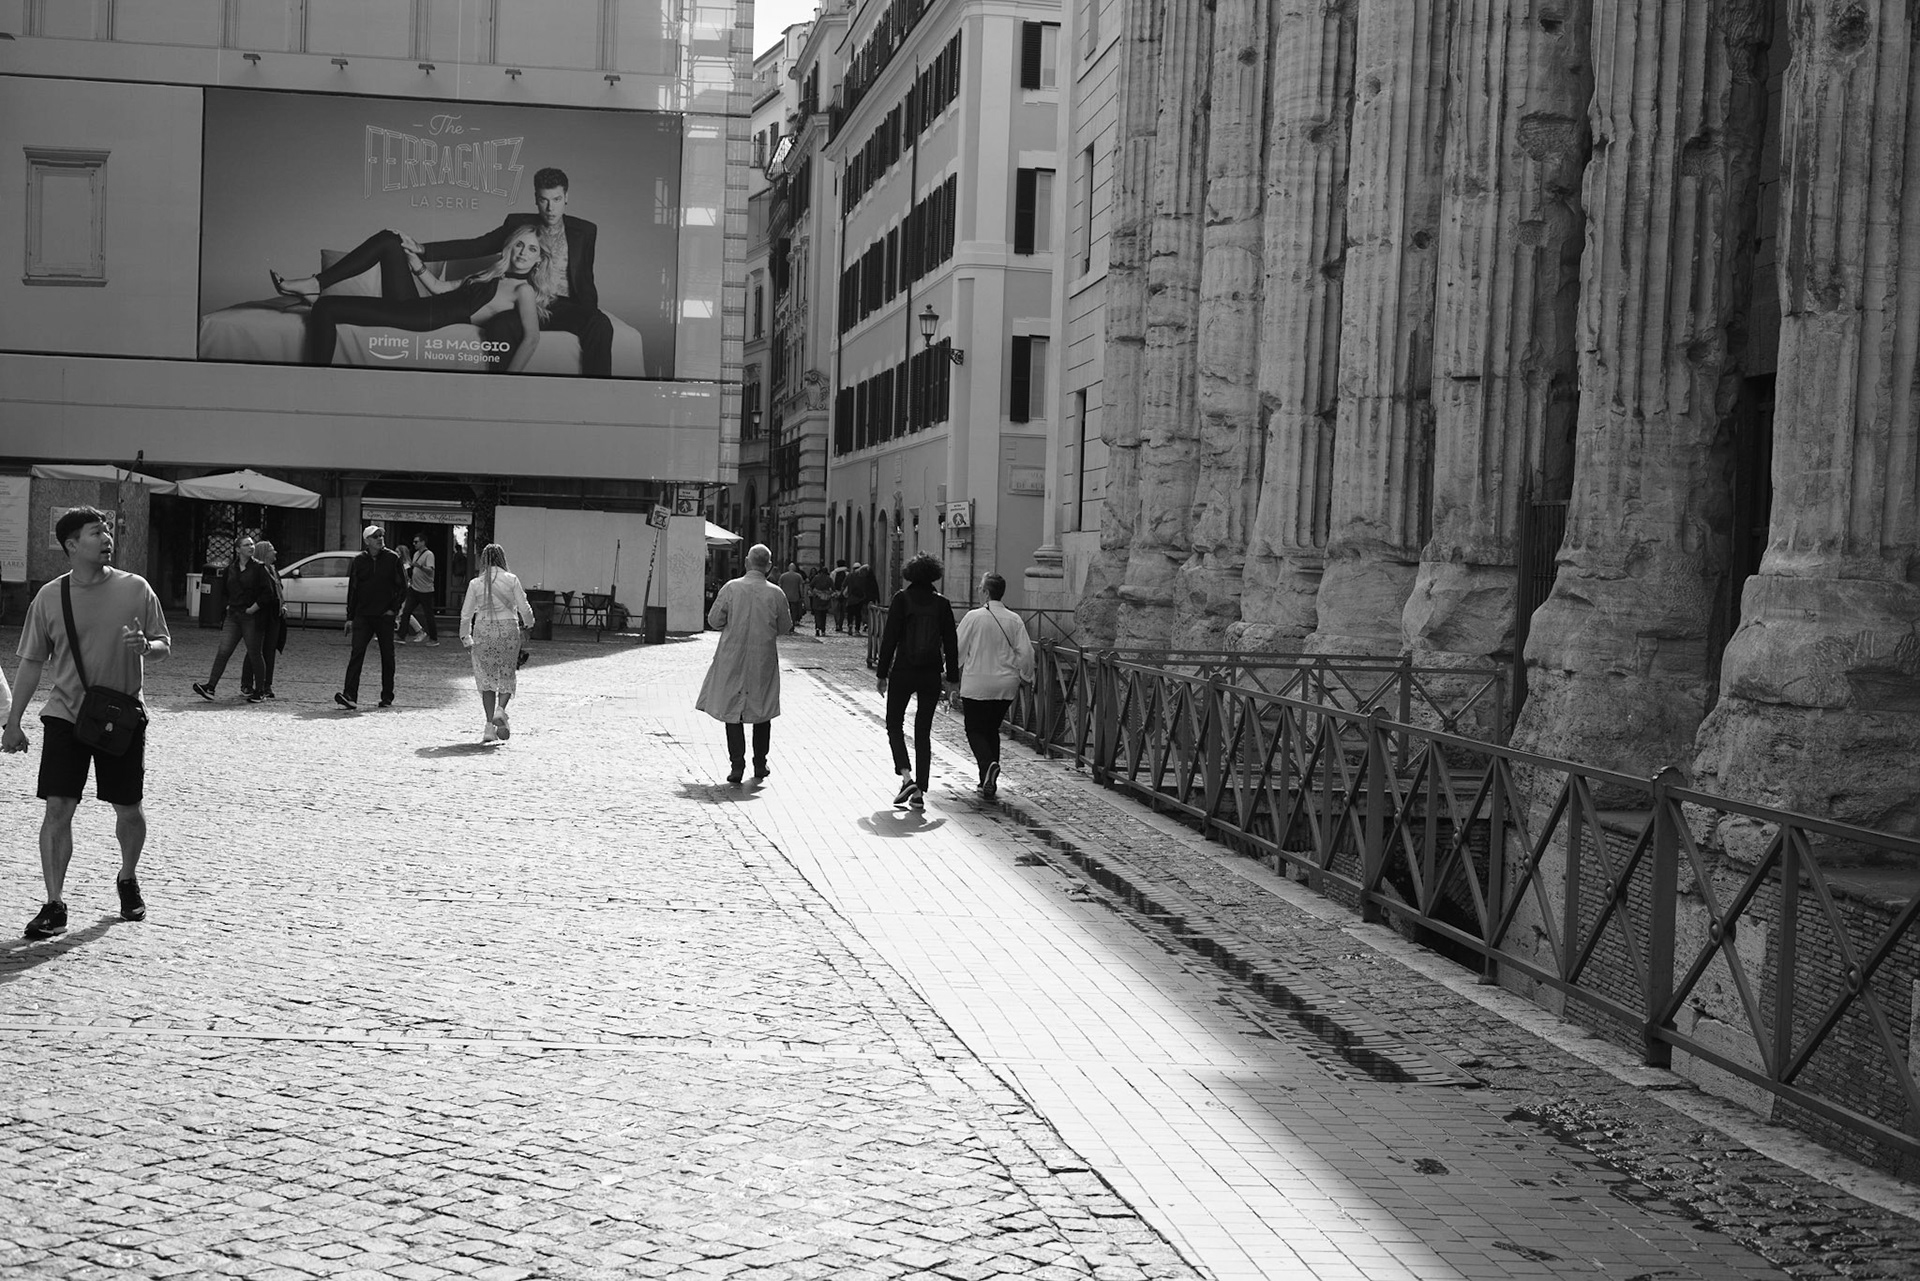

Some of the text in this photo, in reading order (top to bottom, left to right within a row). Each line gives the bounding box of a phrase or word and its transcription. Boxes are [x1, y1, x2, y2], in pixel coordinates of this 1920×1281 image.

[429, 114, 465, 136] The
[411, 195, 480, 210] LA SERIE
[368, 334, 410, 349] prime
[424, 338, 511, 352] 18 MAGGIO
[424, 351, 500, 364] Nuova Stagione
